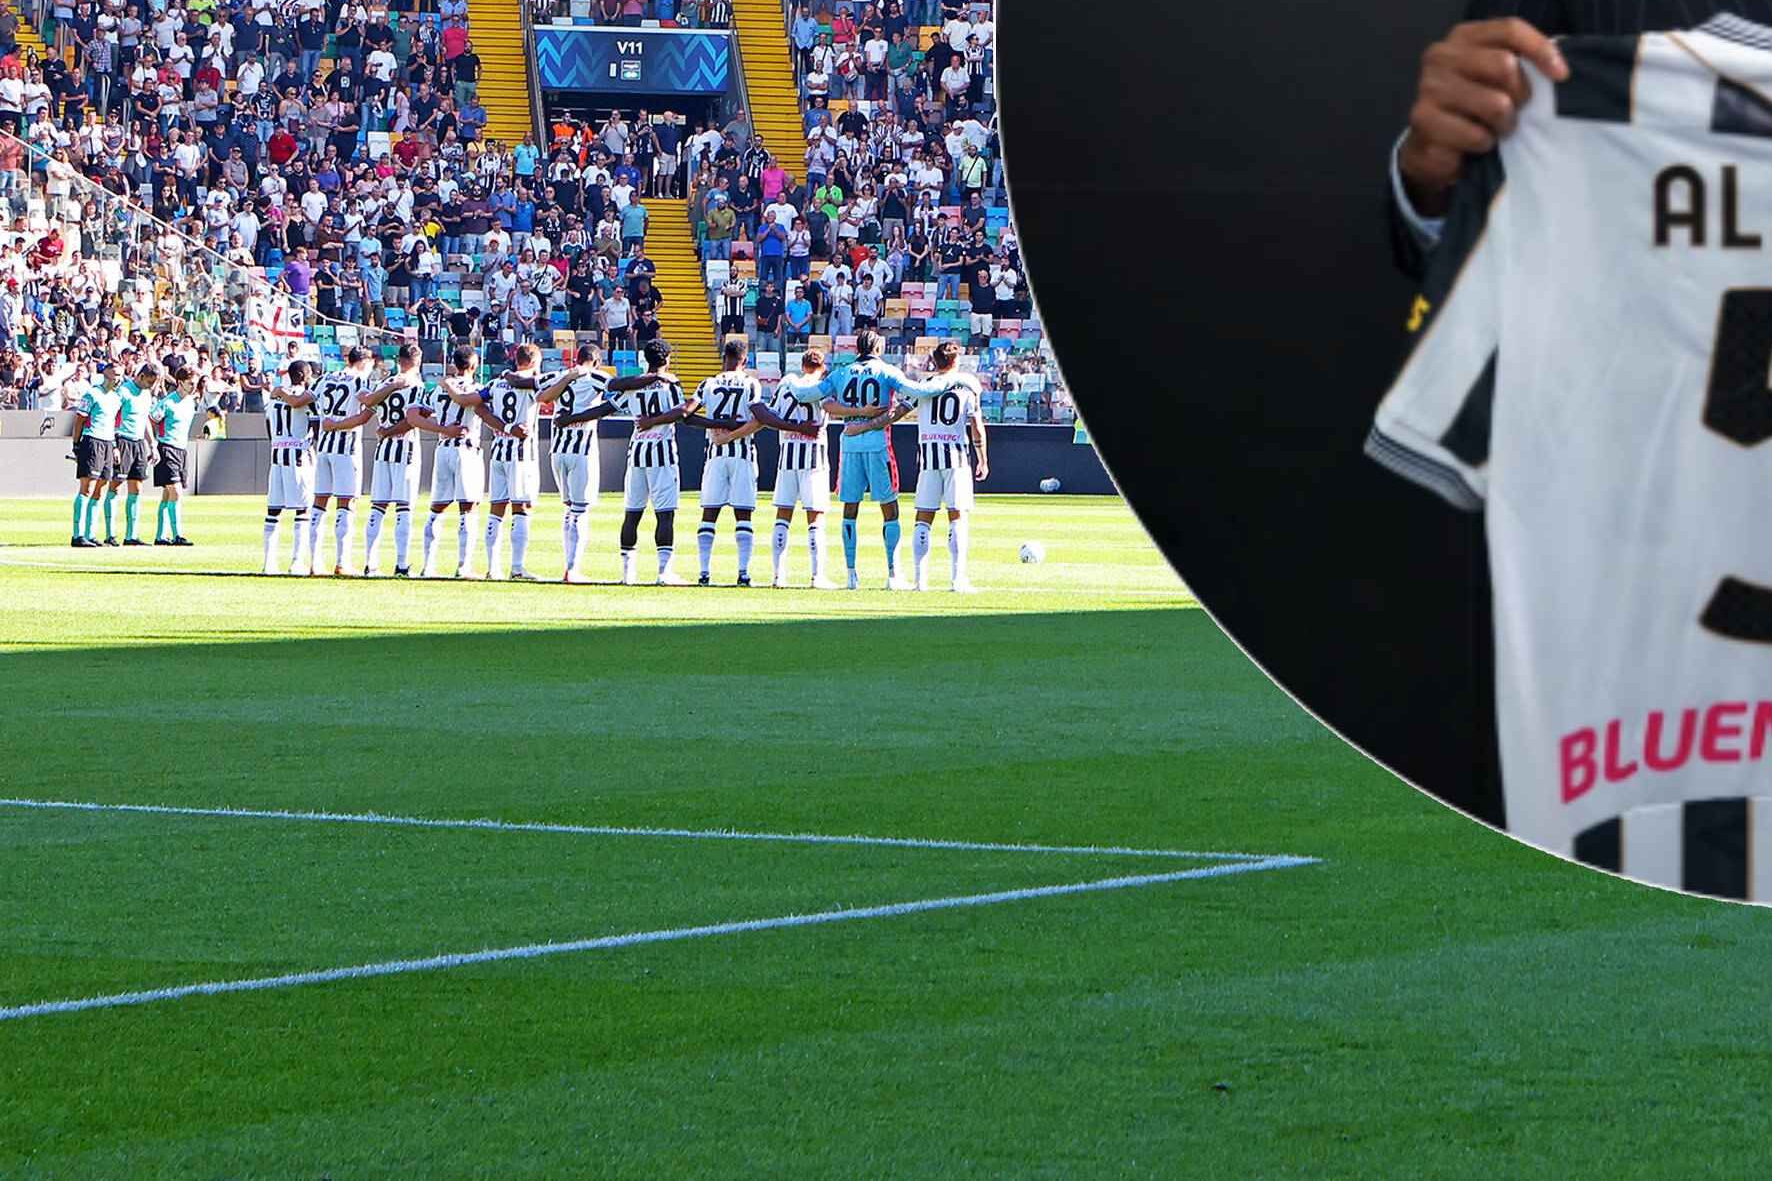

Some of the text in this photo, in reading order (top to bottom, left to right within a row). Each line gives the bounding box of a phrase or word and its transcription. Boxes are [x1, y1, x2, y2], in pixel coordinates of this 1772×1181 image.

[616, 41, 643, 55] V11
[323, 383, 350, 417] 32
[501, 391, 517, 423] 8
[635, 391, 661, 417] 14
[713, 386, 745, 419] 27
[842, 377, 880, 409] 40
[932, 392, 960, 425] 10
